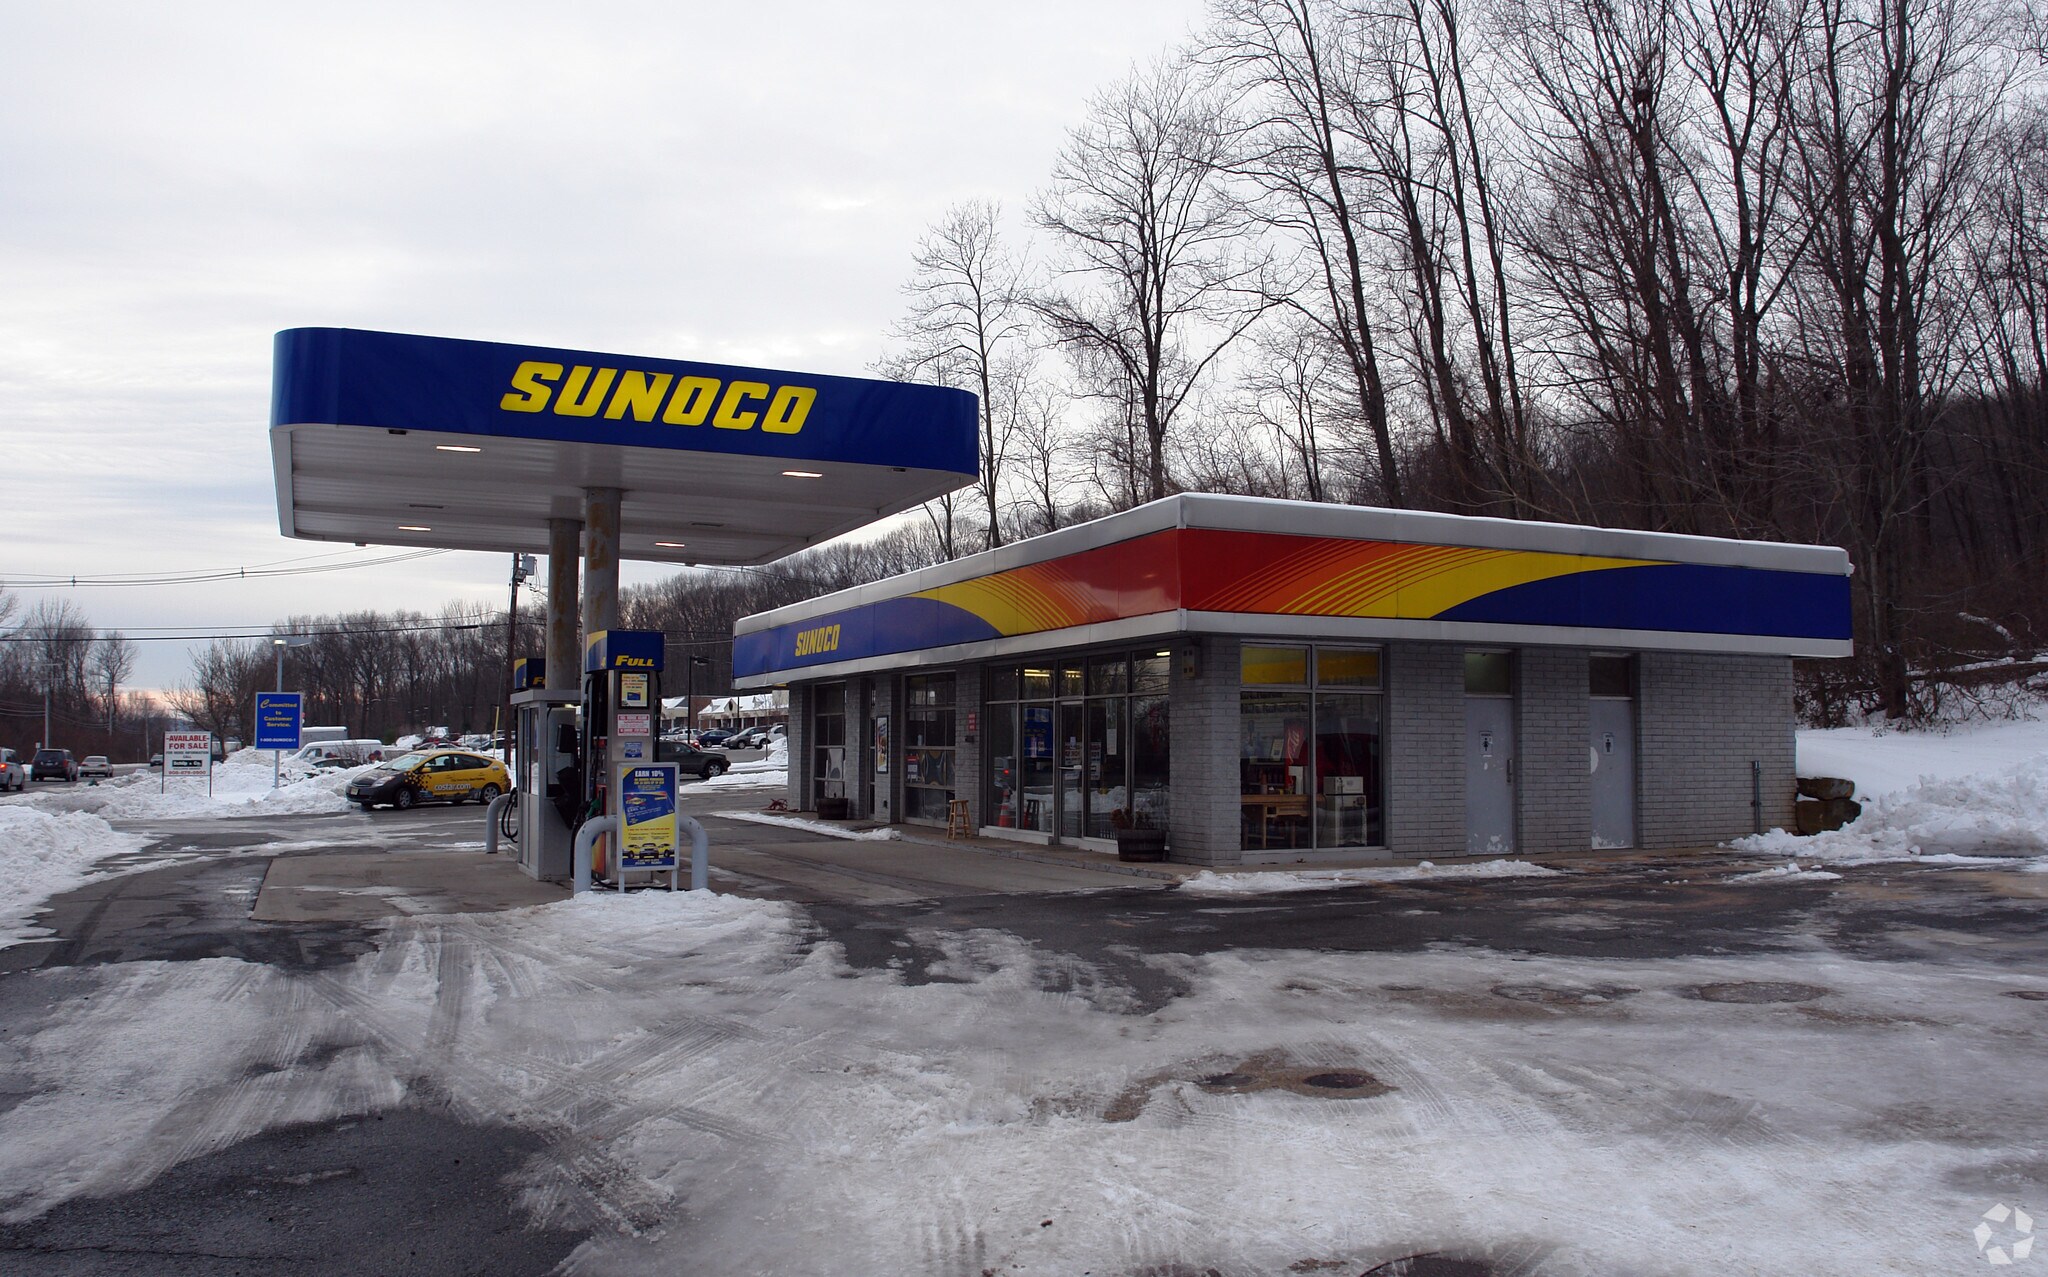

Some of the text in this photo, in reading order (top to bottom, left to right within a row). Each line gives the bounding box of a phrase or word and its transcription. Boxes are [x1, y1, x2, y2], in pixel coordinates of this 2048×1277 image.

[500, 360, 818, 435] SUNOCO
[795, 624, 841, 657] SUNOCO
[615, 654, 655, 667] FULL
[260, 698, 298, 709] Committed
[188, 742, 209, 750] SALE
[434, 783, 472, 791] costar.com
